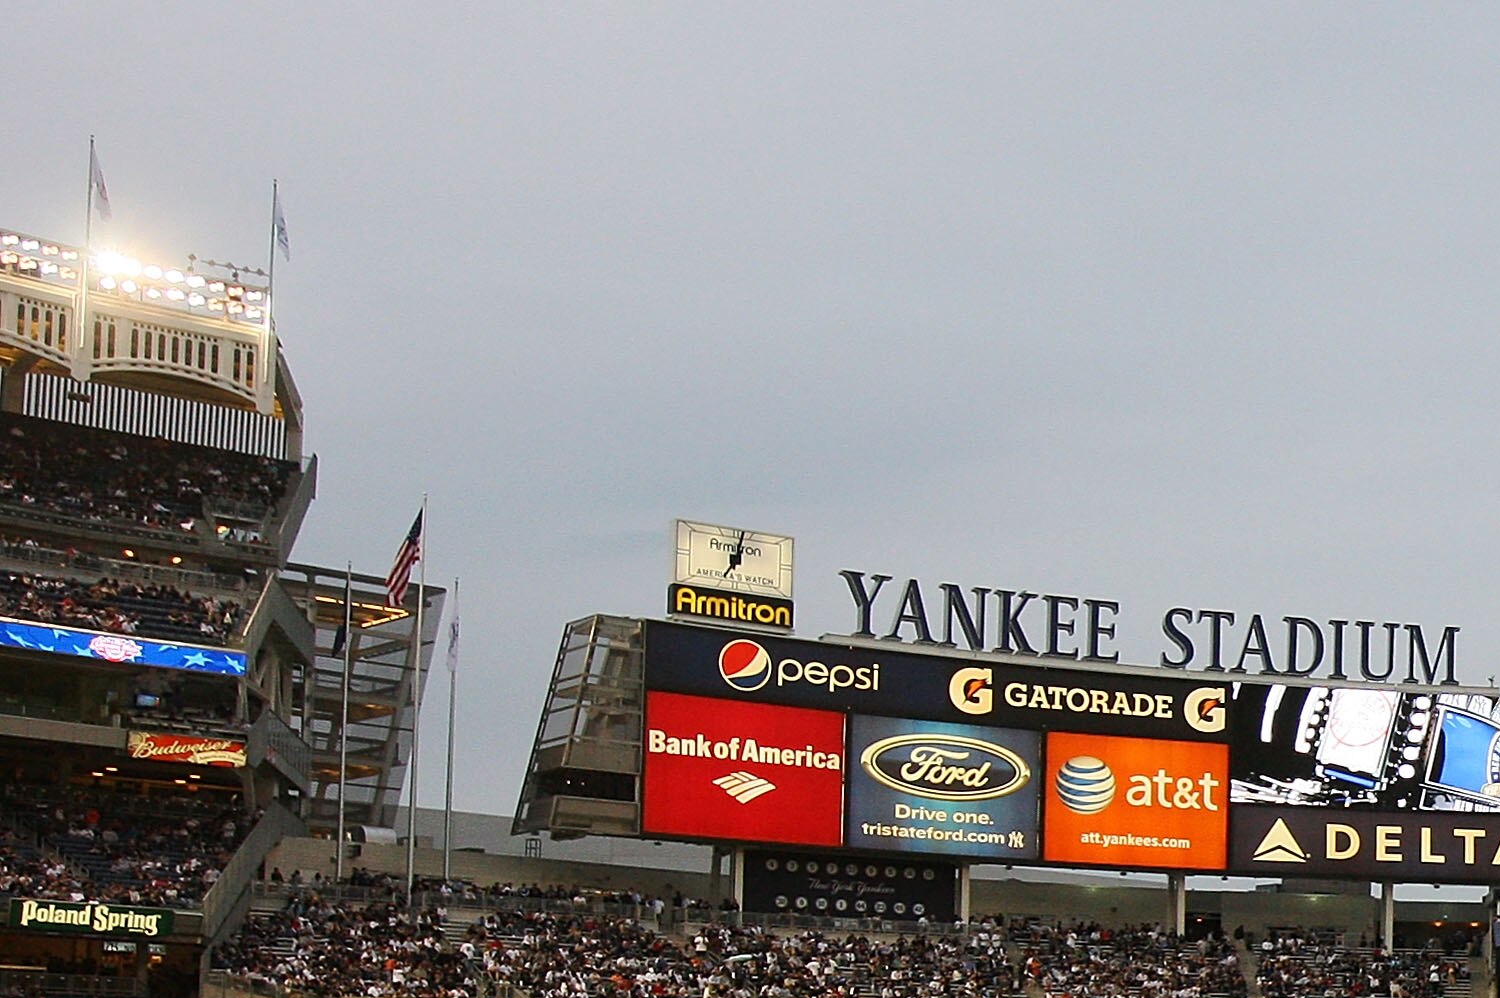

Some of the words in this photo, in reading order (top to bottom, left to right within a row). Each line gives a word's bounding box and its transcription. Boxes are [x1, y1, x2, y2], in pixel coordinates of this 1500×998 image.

[710, 538, 762, 557] Armiron
[697, 568, 743, 581] AMERIA'S
[676, 587, 791, 626] Armitron
[839, 569, 1120, 664] YANKEE
[1160, 607, 1461, 686] STADIUM
[778, 658, 879, 692] pepsi
[1004, 682, 1173, 719] GATORADE
[131, 738, 231, 758] Budweiser
[648, 729, 712, 758] Bank
[714, 737, 740, 761] of
[741, 739, 840, 770] America
[901, 746, 992, 788] Ford
[1126, 768, 1219, 812] at&t
[894, 803, 947, 822] Drive
[953, 811, 994, 825] one.
[861, 822, 1005, 845] tristateford.com
[1081, 832, 1190, 849] att.yankees.com
[21, 901, 91, 926] Poland
[93, 905, 161, 936] Spring
